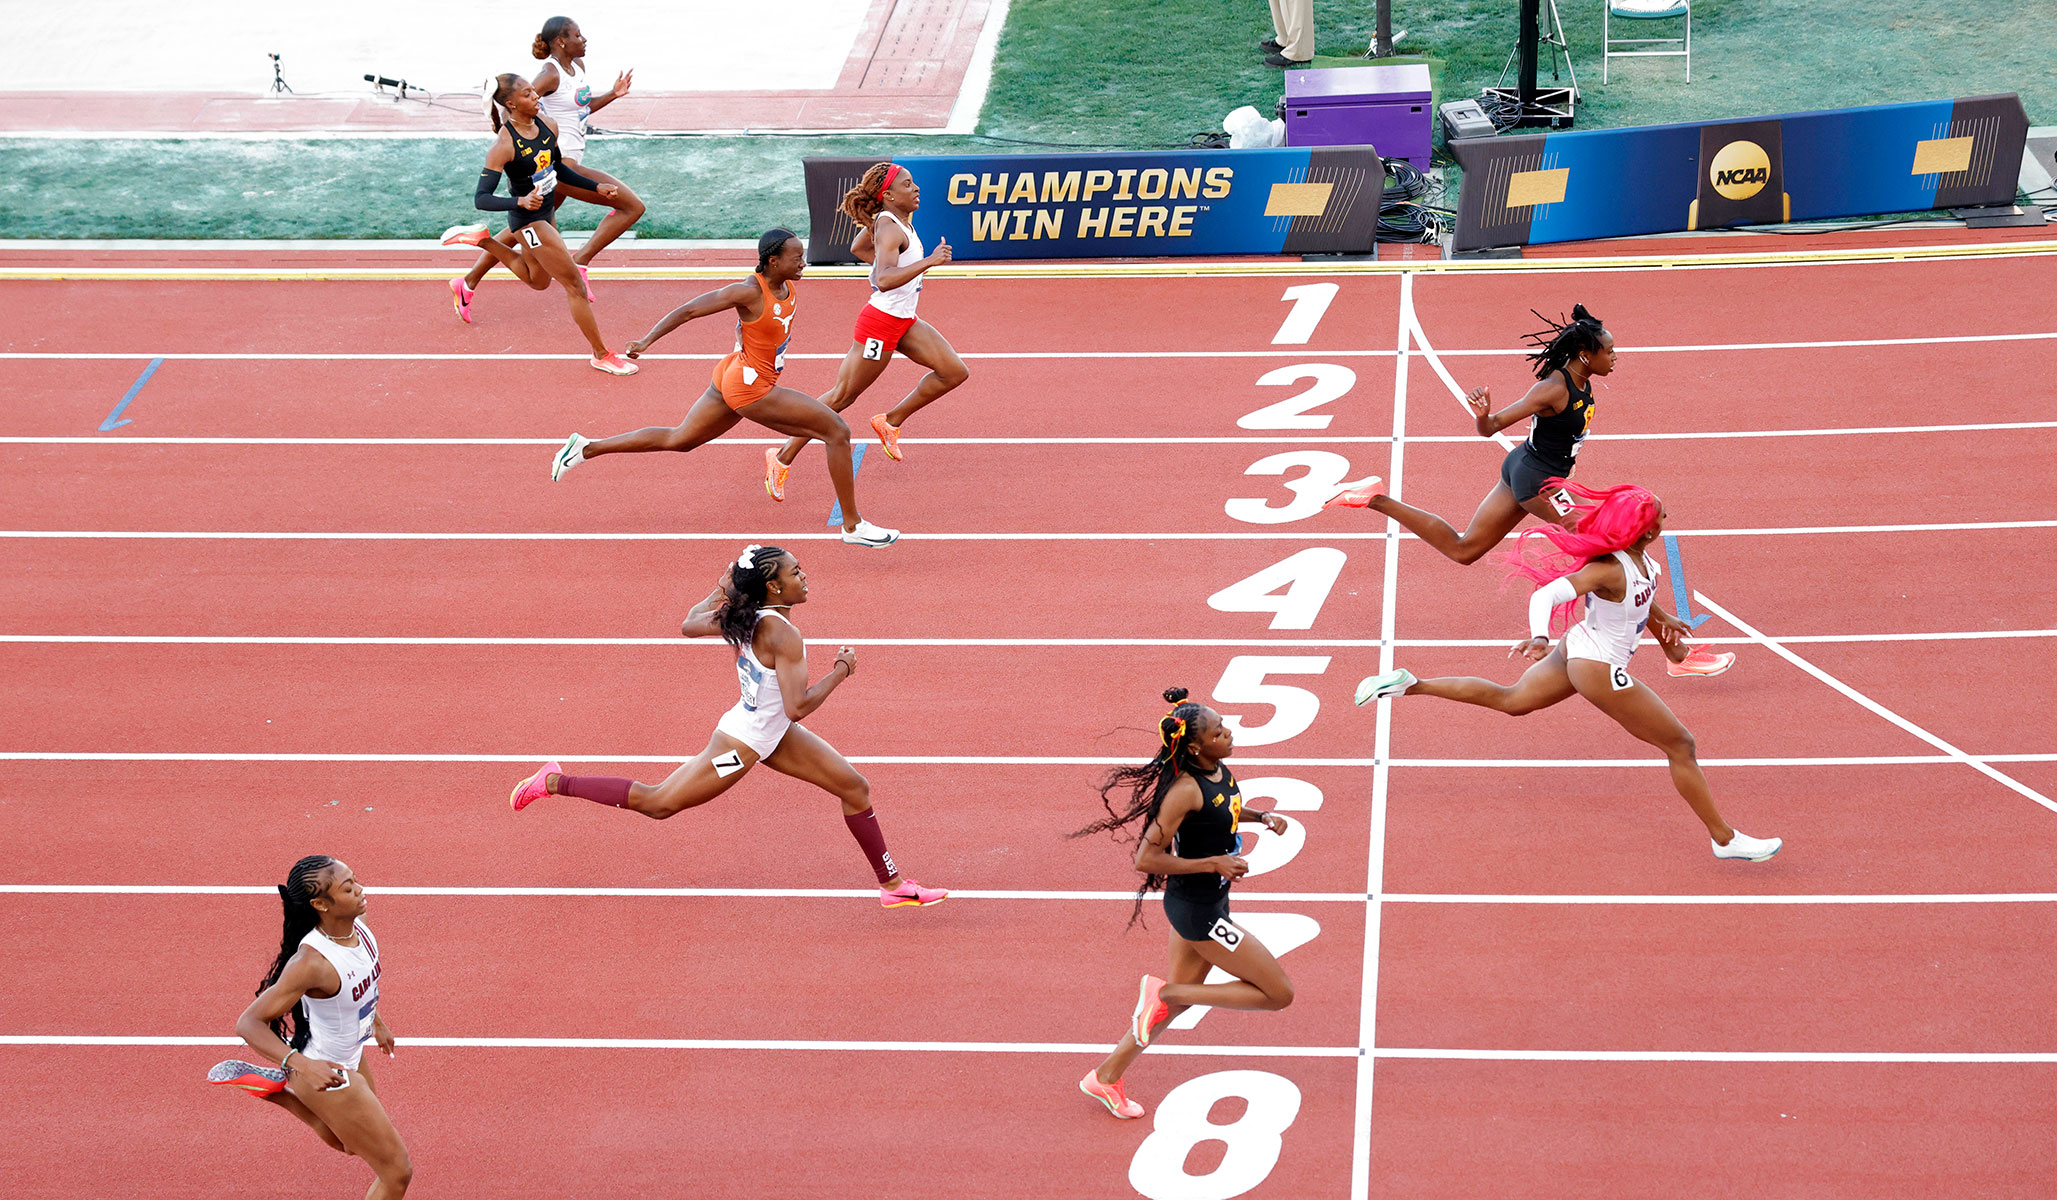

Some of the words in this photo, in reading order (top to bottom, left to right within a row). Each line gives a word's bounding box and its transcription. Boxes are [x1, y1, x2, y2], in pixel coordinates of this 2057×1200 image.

[947, 167, 1234, 206] CHAMPIONS
[1715, 167, 1767, 186] NCAA
[524, 229, 539, 247] 2
[971, 208, 1064, 242] WIN
[1076, 205, 1198, 239] HERE
[1271, 282, 1340, 345] 1
[867, 340, 879, 359] 3
[1237, 363, 1357, 430] 2
[1225, 450, 1351, 525] 3
[1554, 492, 1570, 513] 5
[1207, 547, 1348, 630] 4
[1614, 667, 1628, 687] 6
[1212, 656, 1332, 747] 5
[716, 754, 740, 767] 7
[1229, 777, 1324, 878] 6
[1214, 925, 1239, 946] 8
[1167, 911, 1321, 1030] 7
[1129, 1070, 1302, 1200] 8
